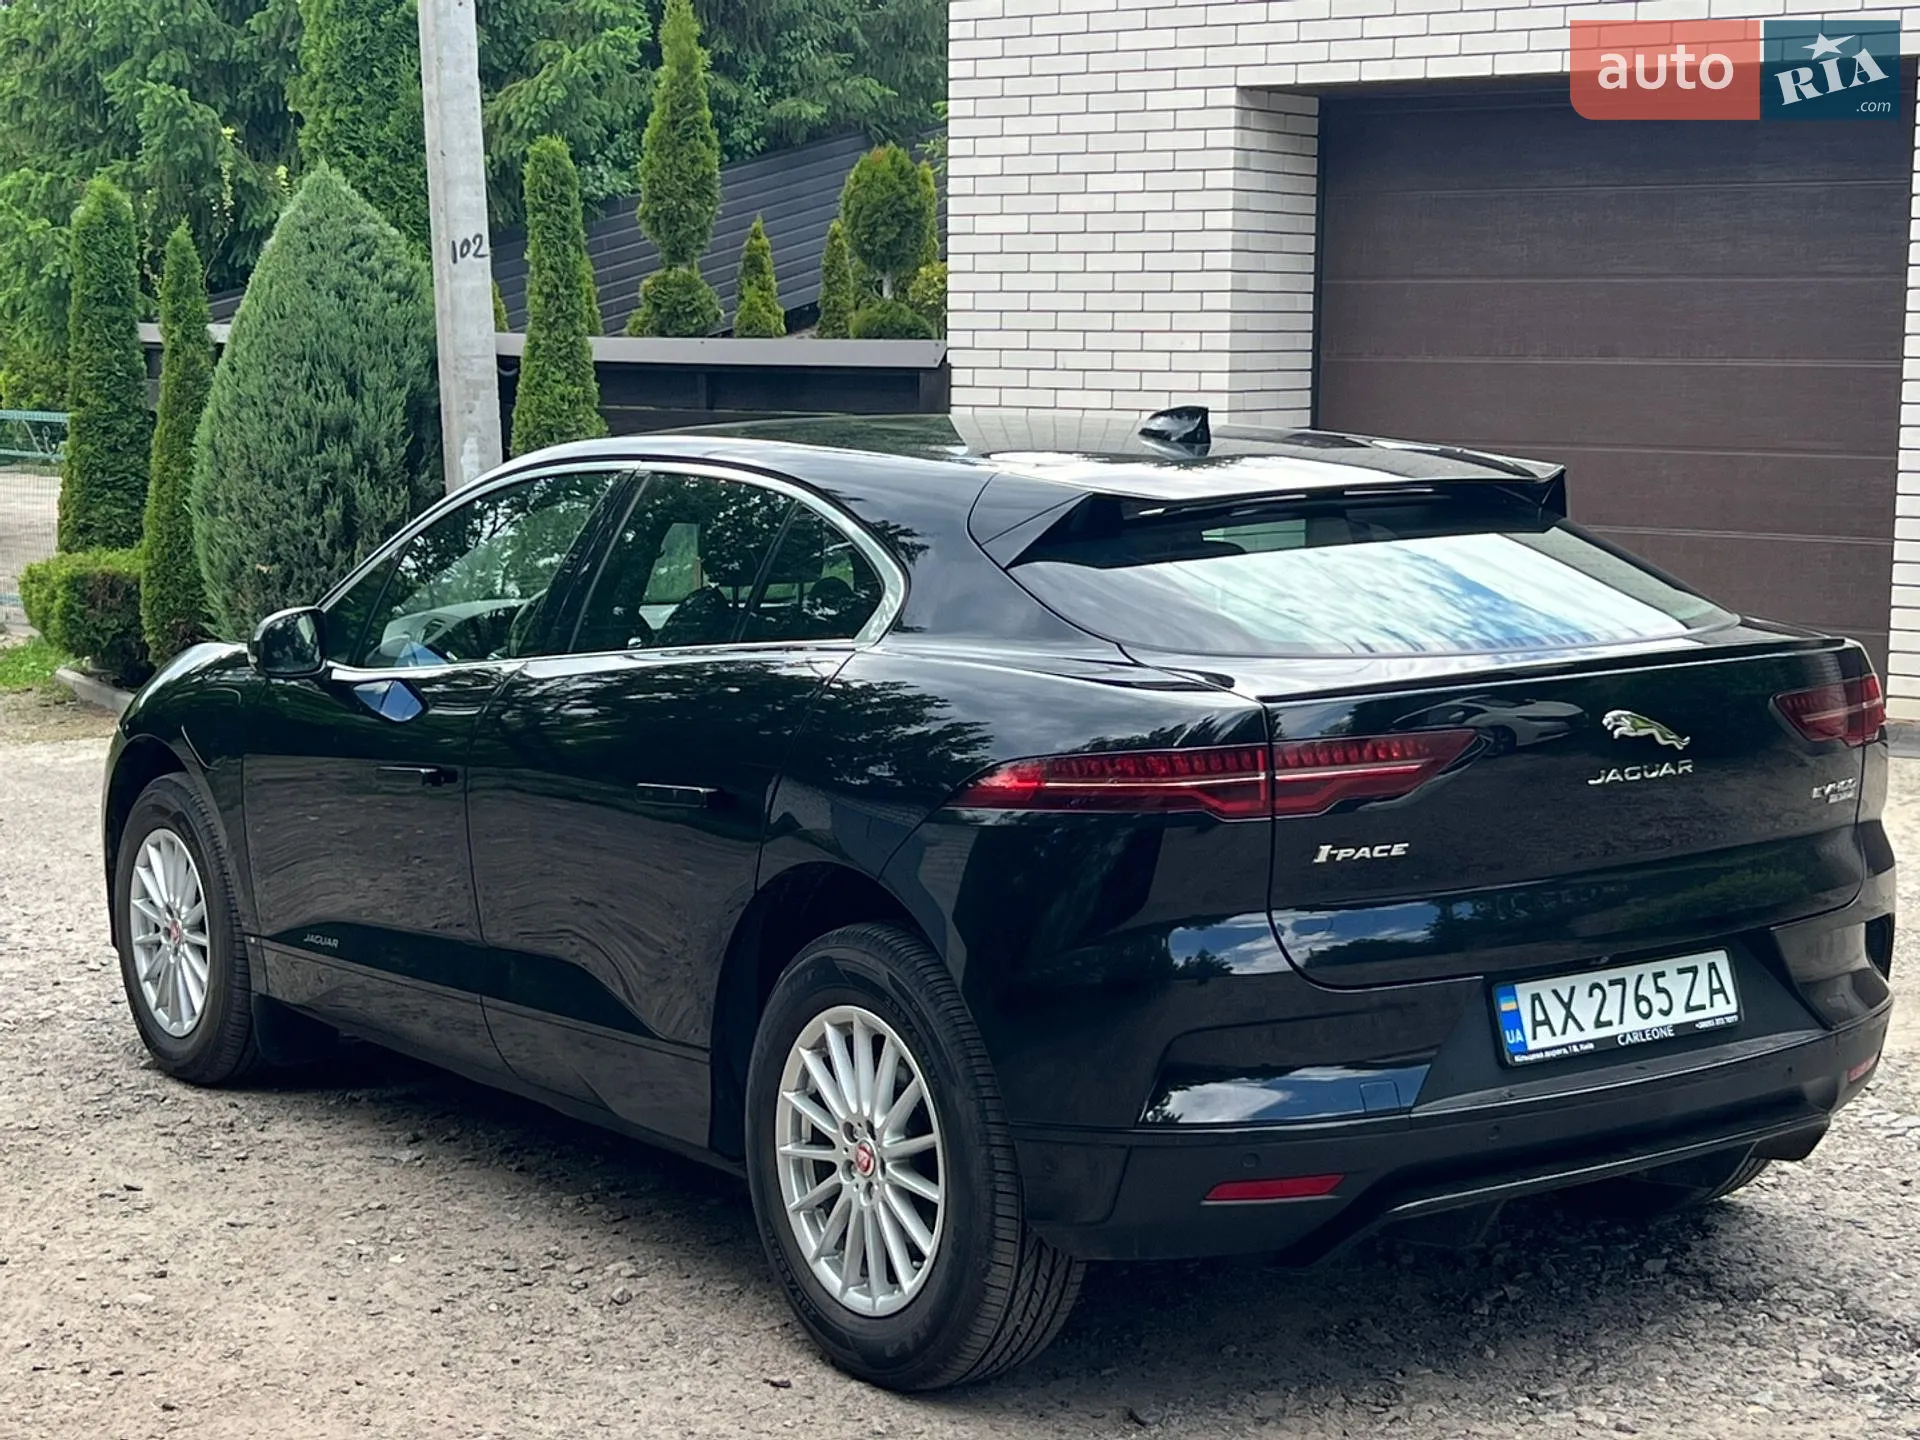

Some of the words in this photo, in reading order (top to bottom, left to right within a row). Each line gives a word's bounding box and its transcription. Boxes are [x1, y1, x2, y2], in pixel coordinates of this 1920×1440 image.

[451, 233, 489, 265] 102
[1587, 758, 1694, 786] JAGUAR
[1530, 984, 1585, 1041] AX
[1587, 970, 1674, 1029] 2765
[1676, 961, 1732, 1014] ZA
[1504, 1028, 1525, 1045] UA
[1617, 1024, 1676, 1047] CARLEONE
